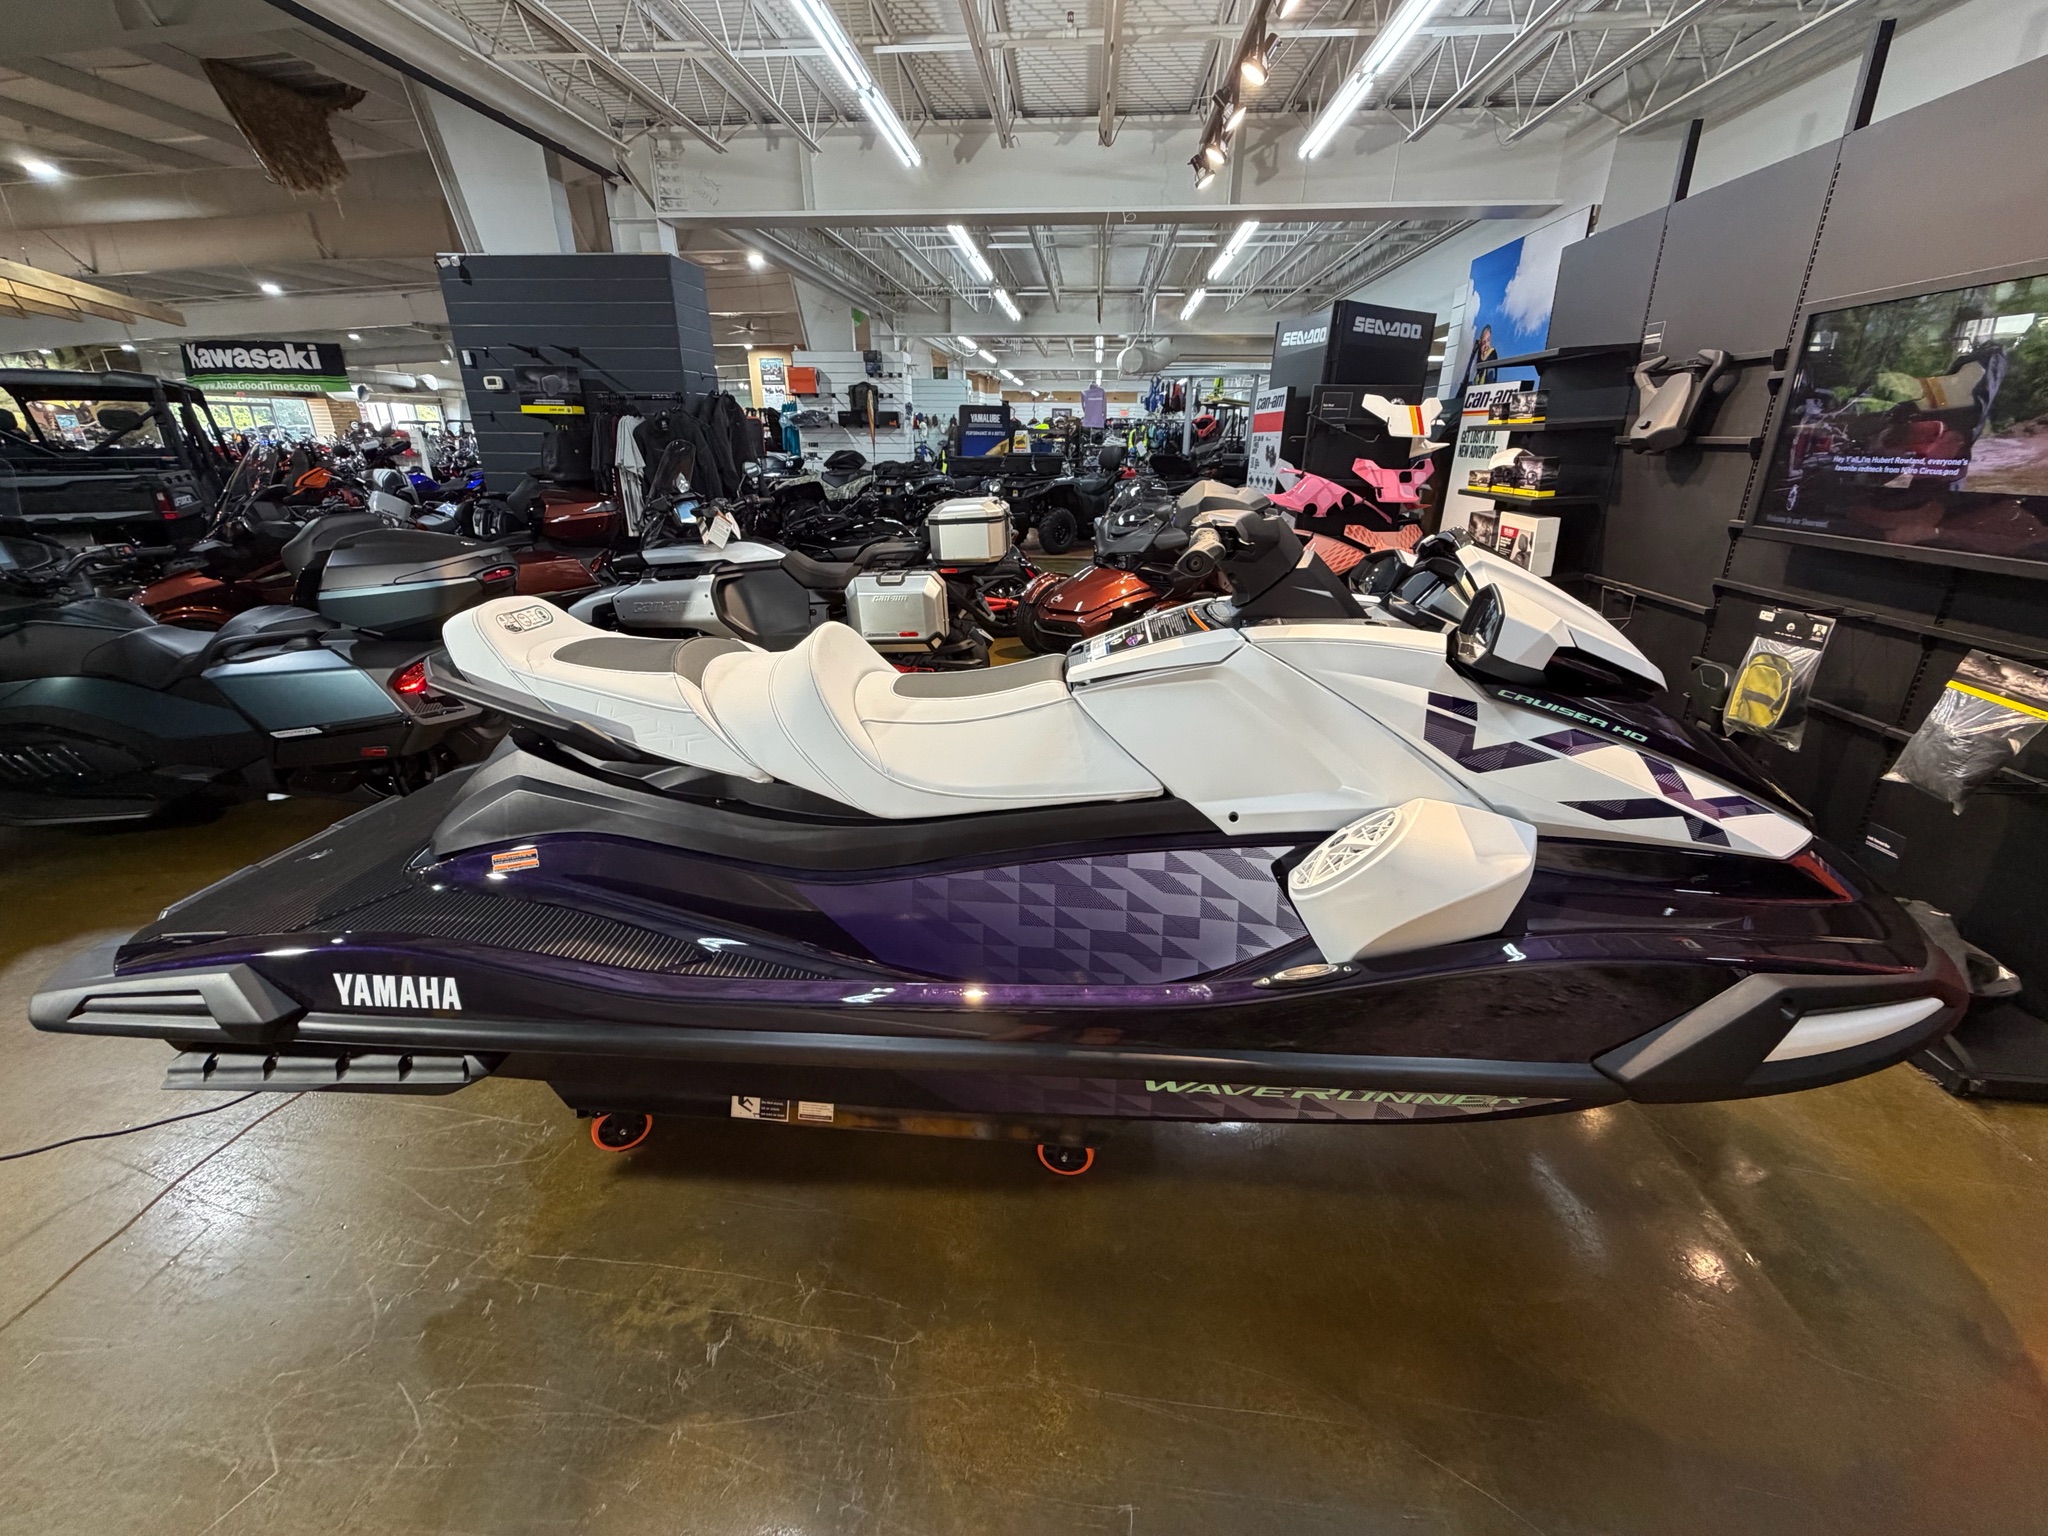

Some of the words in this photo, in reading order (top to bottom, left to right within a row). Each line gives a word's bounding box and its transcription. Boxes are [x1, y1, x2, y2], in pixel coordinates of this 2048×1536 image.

[186, 343, 322, 370] Kawasaki
[1256, 394, 1285, 410] can-am
[970, 413, 1001, 423] YAMALUBE
[1460, 430, 1470, 443] GET
[1470, 430, 1483, 444] LOST
[1458, 445, 1470, 458] NEW
[1833, 455, 1845, 464] Hey
[1872, 456, 1894, 464] Hubert
[1894, 457, 1926, 465] Rowland,
[1927, 458, 1968, 467] everyone's
[1834, 464, 1858, 472] favorite
[1858, 465, 1883, 473] redneck
[1900, 466, 1918, 474] Nitro
[1919, 467, 1942, 475] Circus
[1943, 468, 1959, 476] and
[1497, 689, 1608, 728] CRUISER
[1612, 725, 1649, 743] HO
[333, 973, 462, 1010] YAMAHA
[1145, 1080, 1528, 1105] WAVERUNNER
